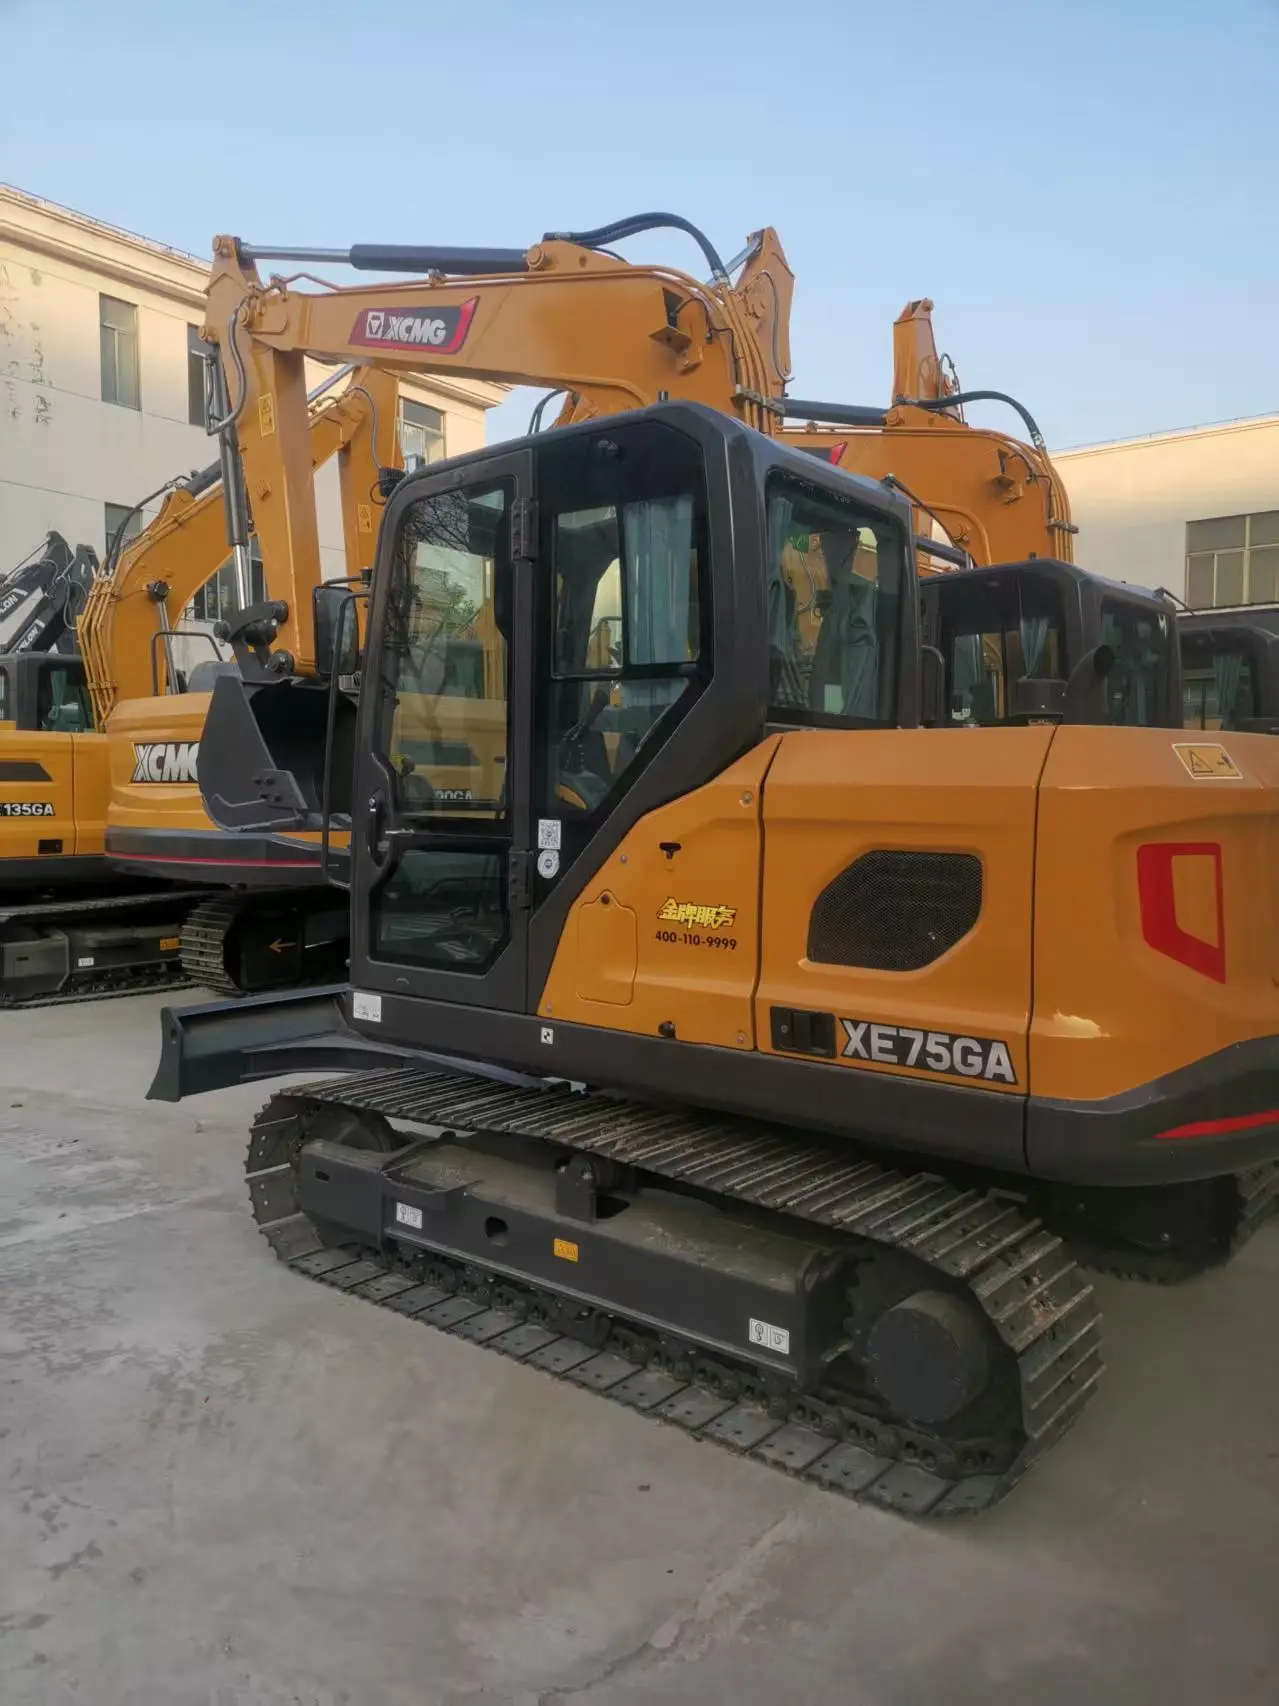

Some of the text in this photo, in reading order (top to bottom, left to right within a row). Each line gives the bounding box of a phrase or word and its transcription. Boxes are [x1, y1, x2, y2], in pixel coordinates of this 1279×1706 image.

[382, 316, 447, 345] XCMG
[0, 803, 54, 816] 135GA
[657, 897, 737, 929] 金牌服务
[656, 931, 737, 950] 400-110-9999
[841, 1019, 1016, 1083] XE75GA
